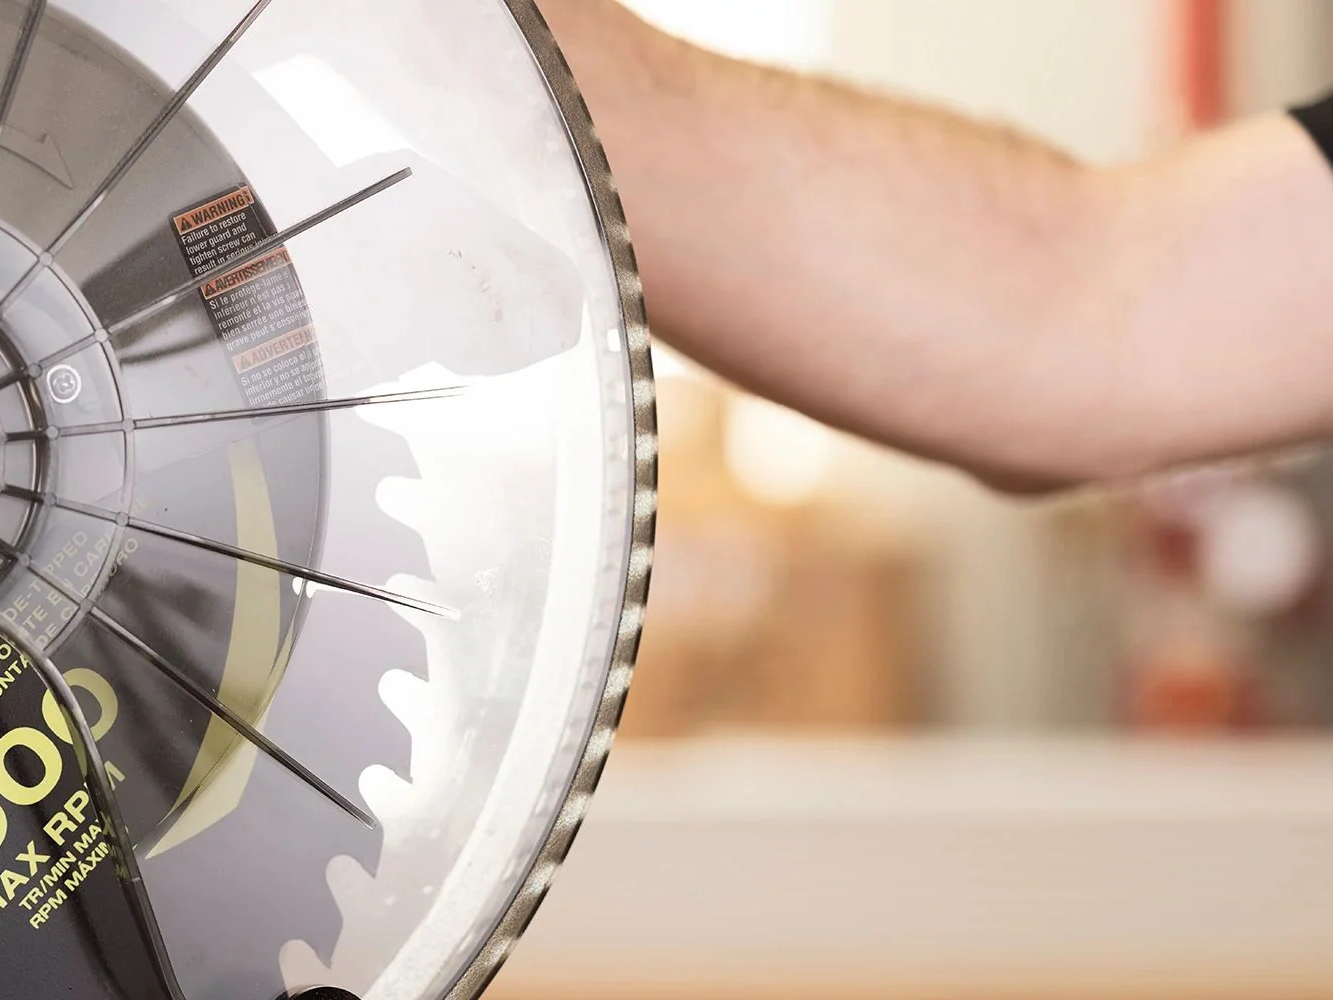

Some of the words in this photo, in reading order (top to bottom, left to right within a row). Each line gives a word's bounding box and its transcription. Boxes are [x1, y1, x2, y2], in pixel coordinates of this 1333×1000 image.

[190, 193, 246, 226] WARNING
[181, 228, 210, 245] Failure
[209, 224, 218, 233] to
[219, 212, 247, 229] restore
[186, 242, 209, 256] lower
[208, 229, 232, 248] guard
[232, 223, 247, 236] and
[189, 247, 217, 266] tighten
[218, 236, 242, 254] screw
[241, 231, 256, 244] can
[194, 258, 217, 275] result
[18, 850, 77, 911] TR/MIN
[29, 888, 68, 930] RPM
